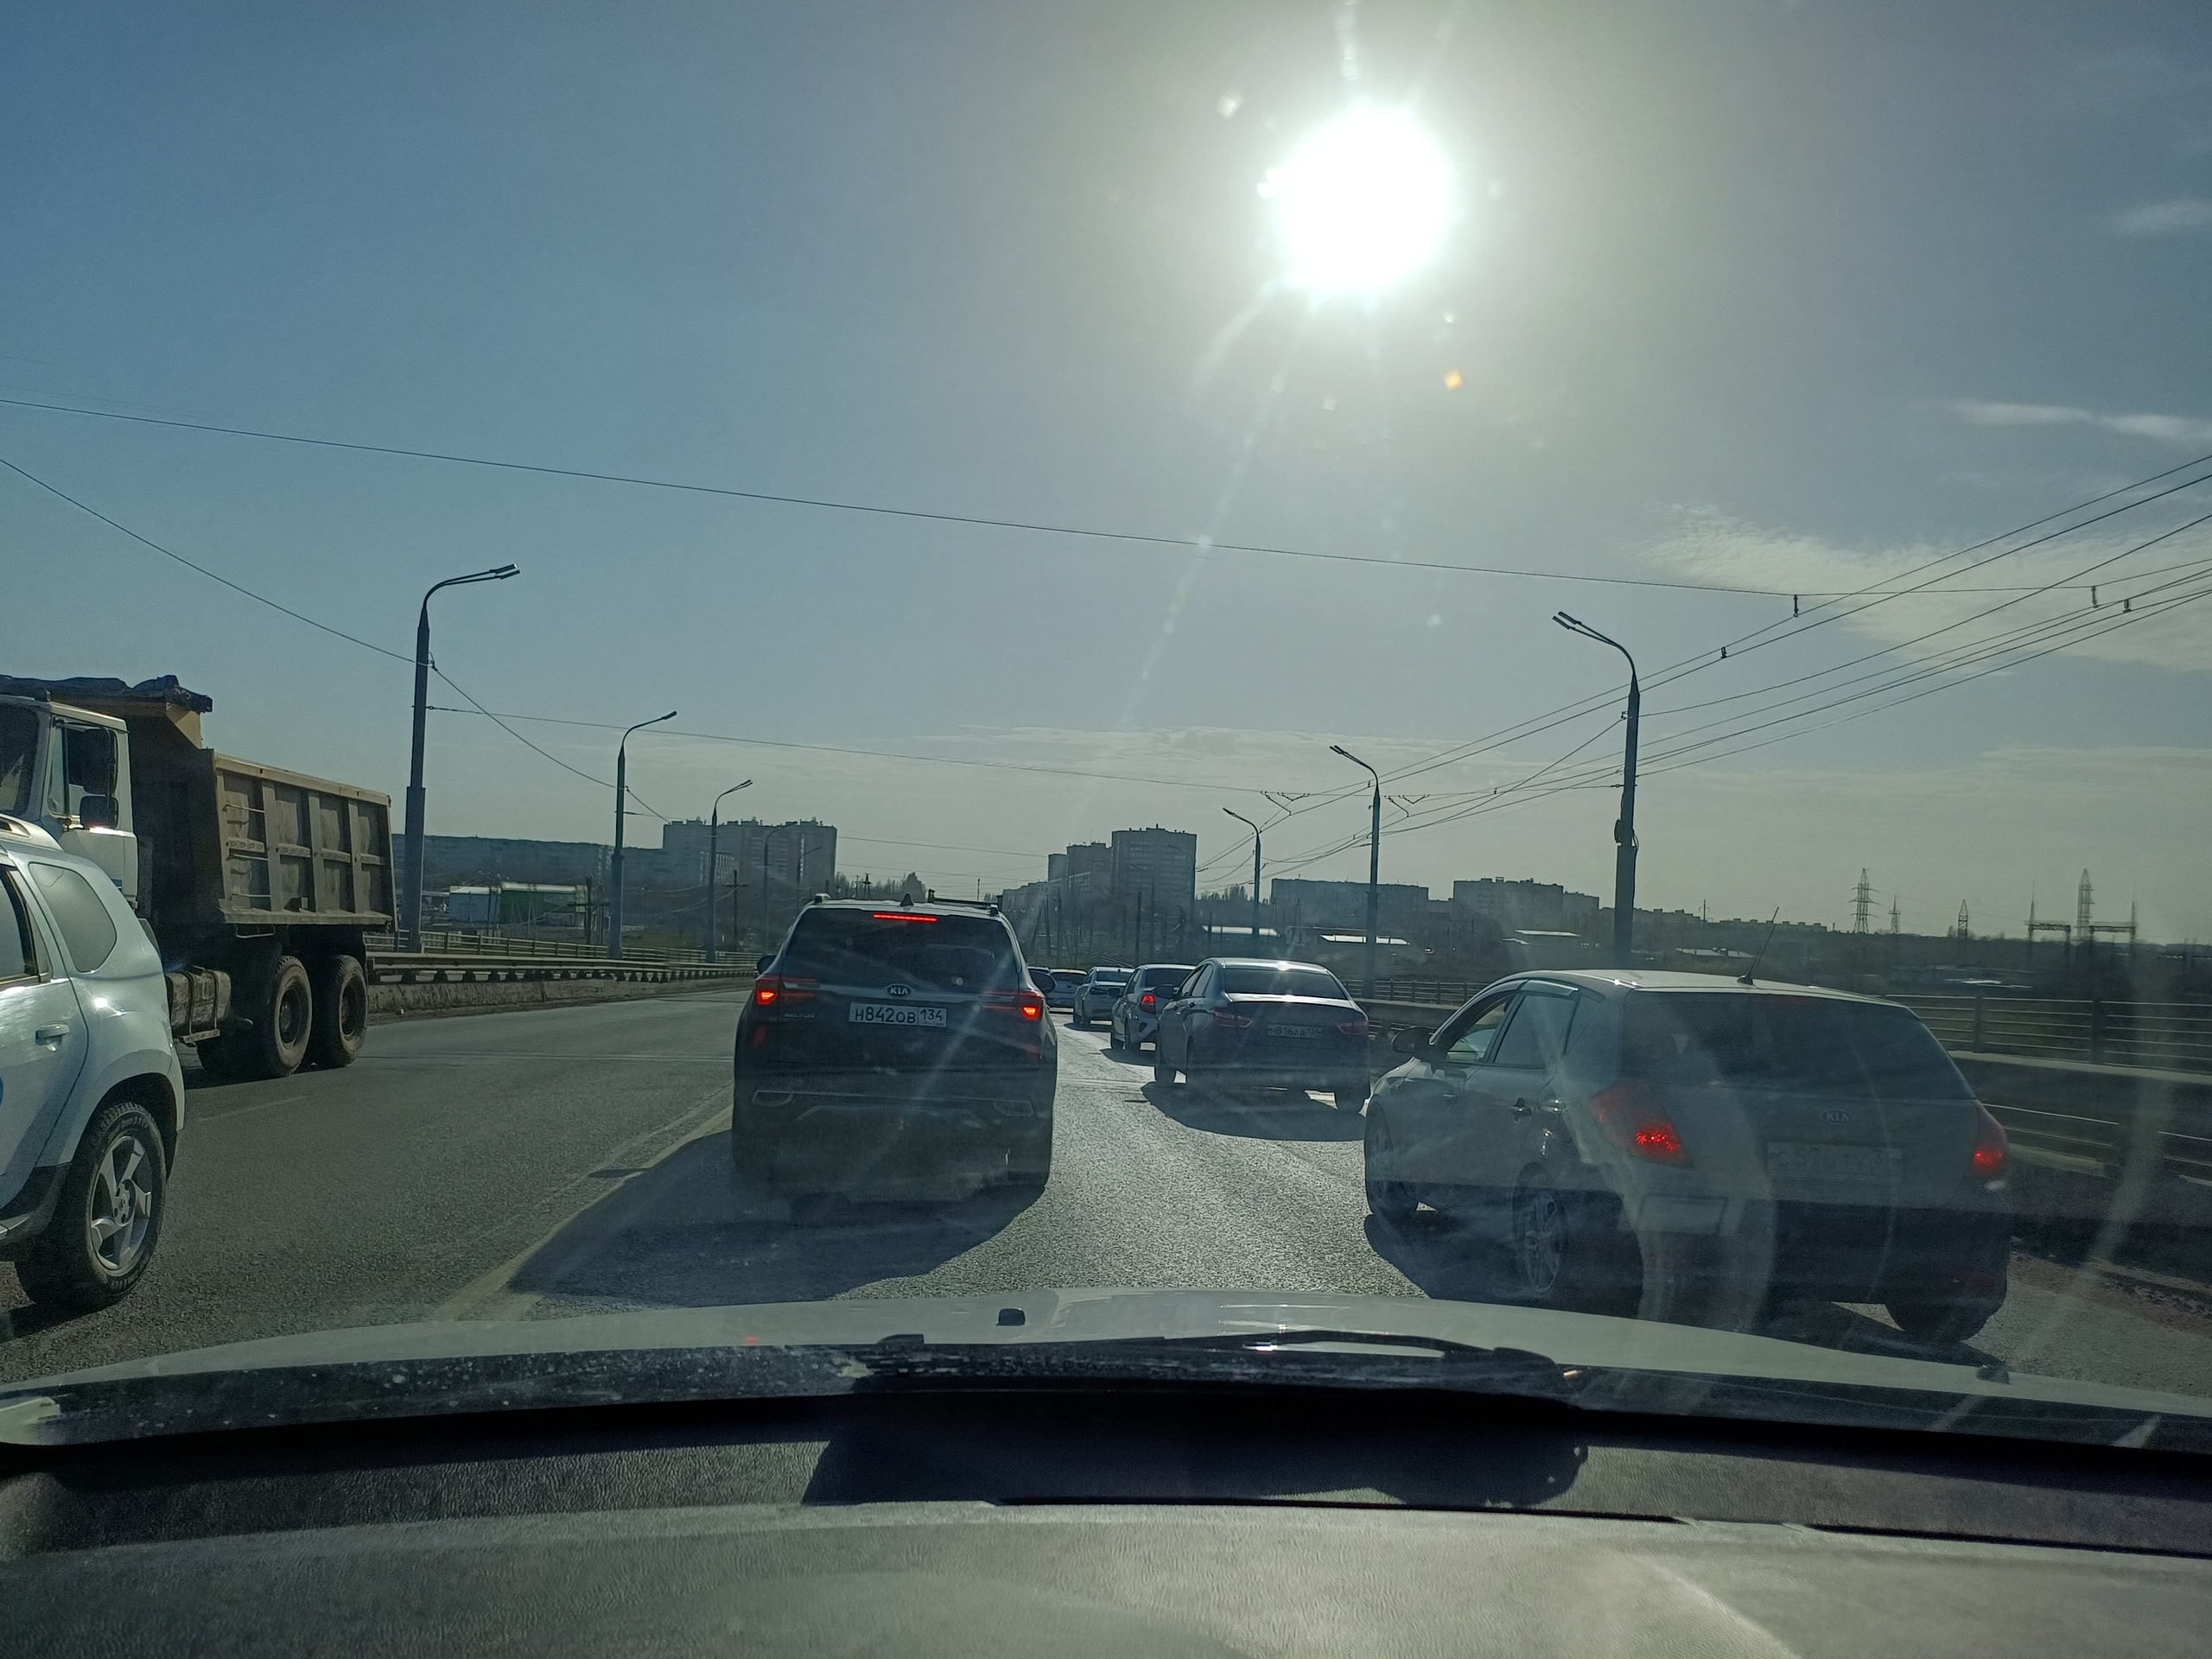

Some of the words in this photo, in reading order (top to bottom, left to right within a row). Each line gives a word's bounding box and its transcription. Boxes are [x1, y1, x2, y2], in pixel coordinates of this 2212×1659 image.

[890, 987, 909, 995] KIA
[919, 1008, 943, 1021] 134
[1826, 1109, 1849, 1122] KIA
